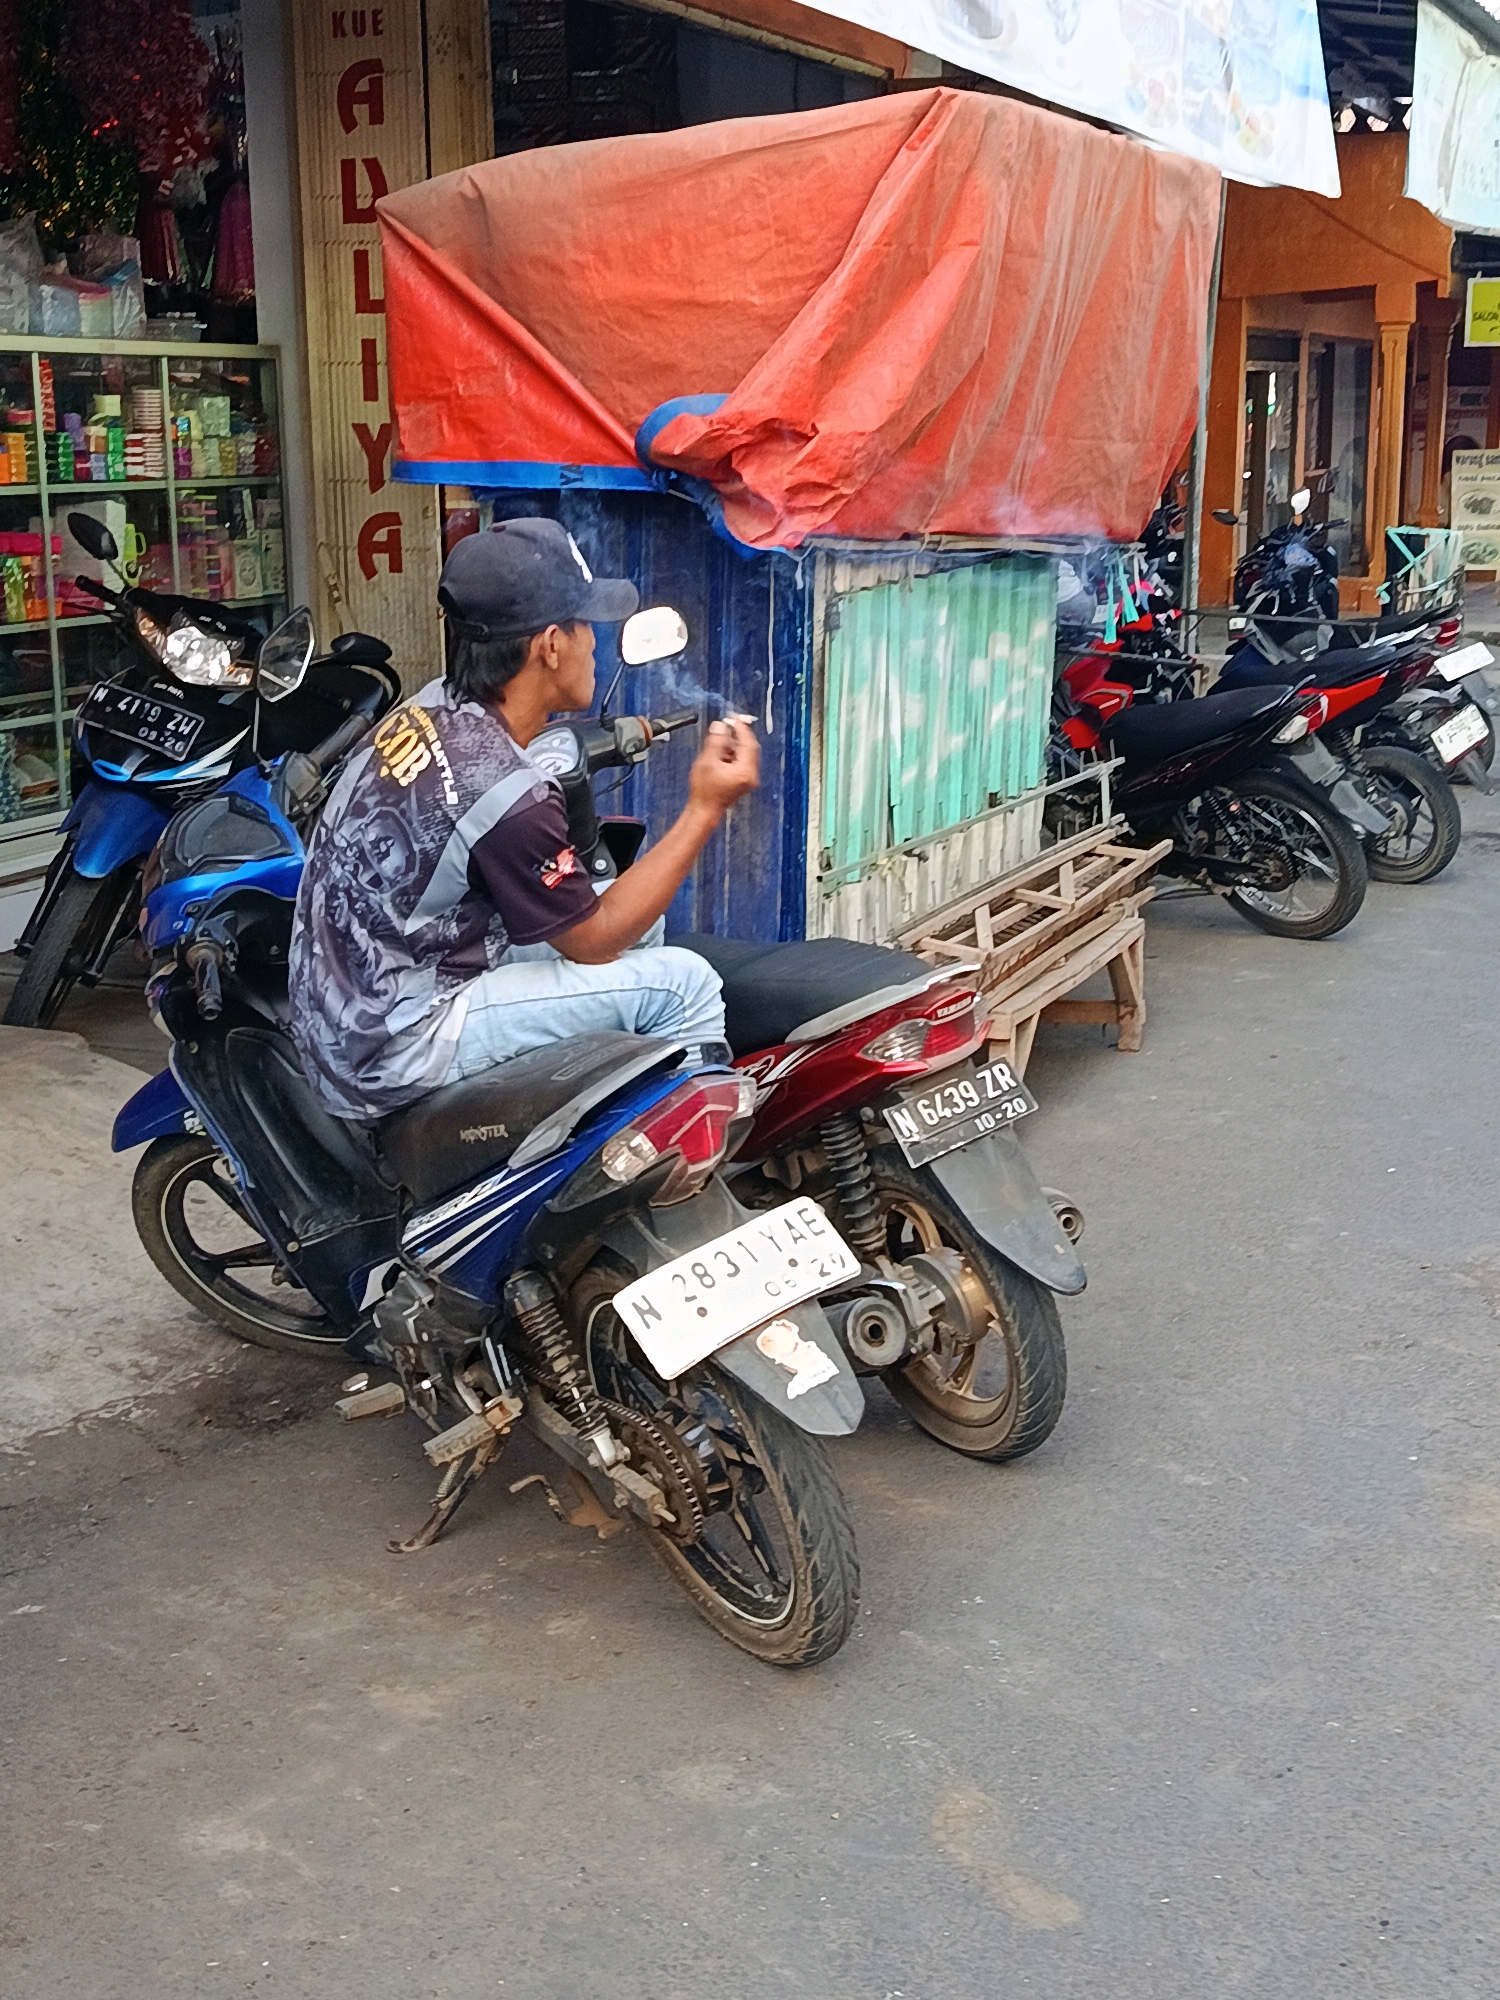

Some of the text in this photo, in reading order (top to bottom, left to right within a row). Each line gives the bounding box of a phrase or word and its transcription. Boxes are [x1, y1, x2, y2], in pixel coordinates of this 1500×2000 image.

[331, 9, 384, 38] KUE
[93, 687, 109, 702] N
[892, 1063, 1018, 1139] N 6439 ZR
[631, 1207, 826, 1330] N 2831 YAE
